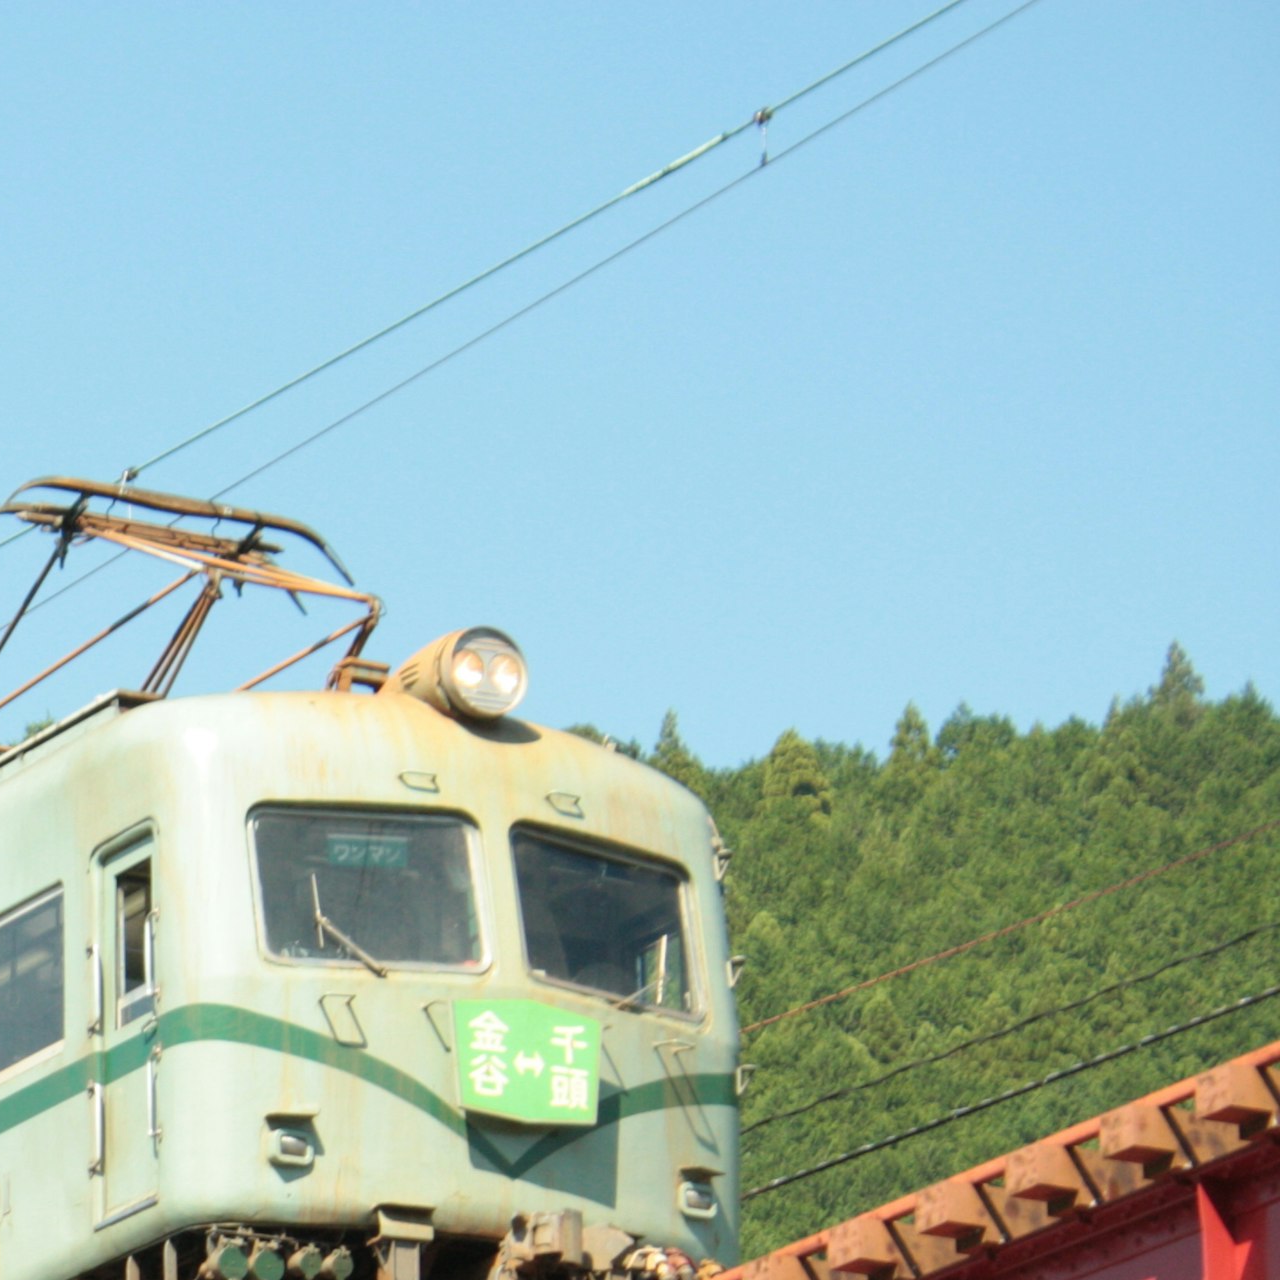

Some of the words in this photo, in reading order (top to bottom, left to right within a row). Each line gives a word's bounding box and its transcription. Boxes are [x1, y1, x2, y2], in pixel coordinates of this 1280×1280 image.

[334, 844, 401, 863] ワンマン
[467, 1009, 510, 1097] 金谷
[549, 1025, 589, 1110] 千頭
